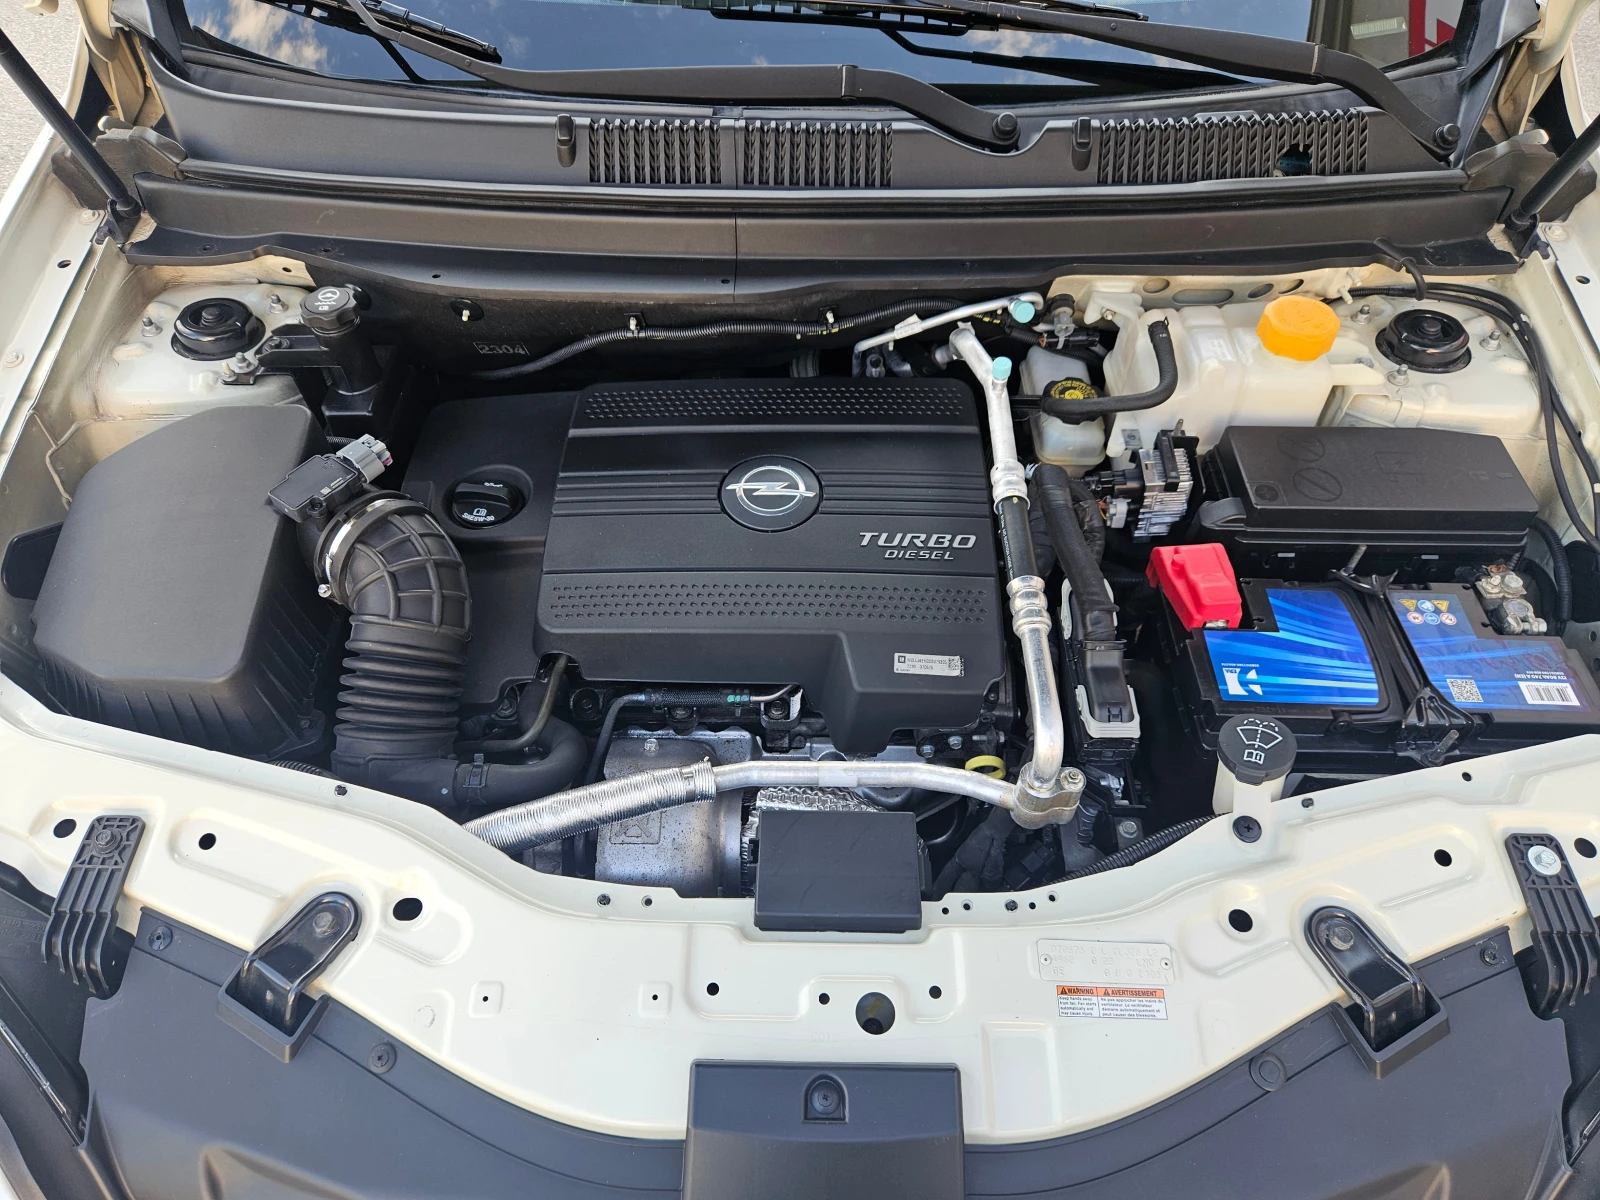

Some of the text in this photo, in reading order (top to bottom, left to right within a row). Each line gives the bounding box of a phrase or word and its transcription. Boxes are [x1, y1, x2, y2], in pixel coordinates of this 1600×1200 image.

[478, 344, 526, 354] 2304
[860, 532, 976, 548] TURBO
[884, 550, 954, 560] DIESEL
